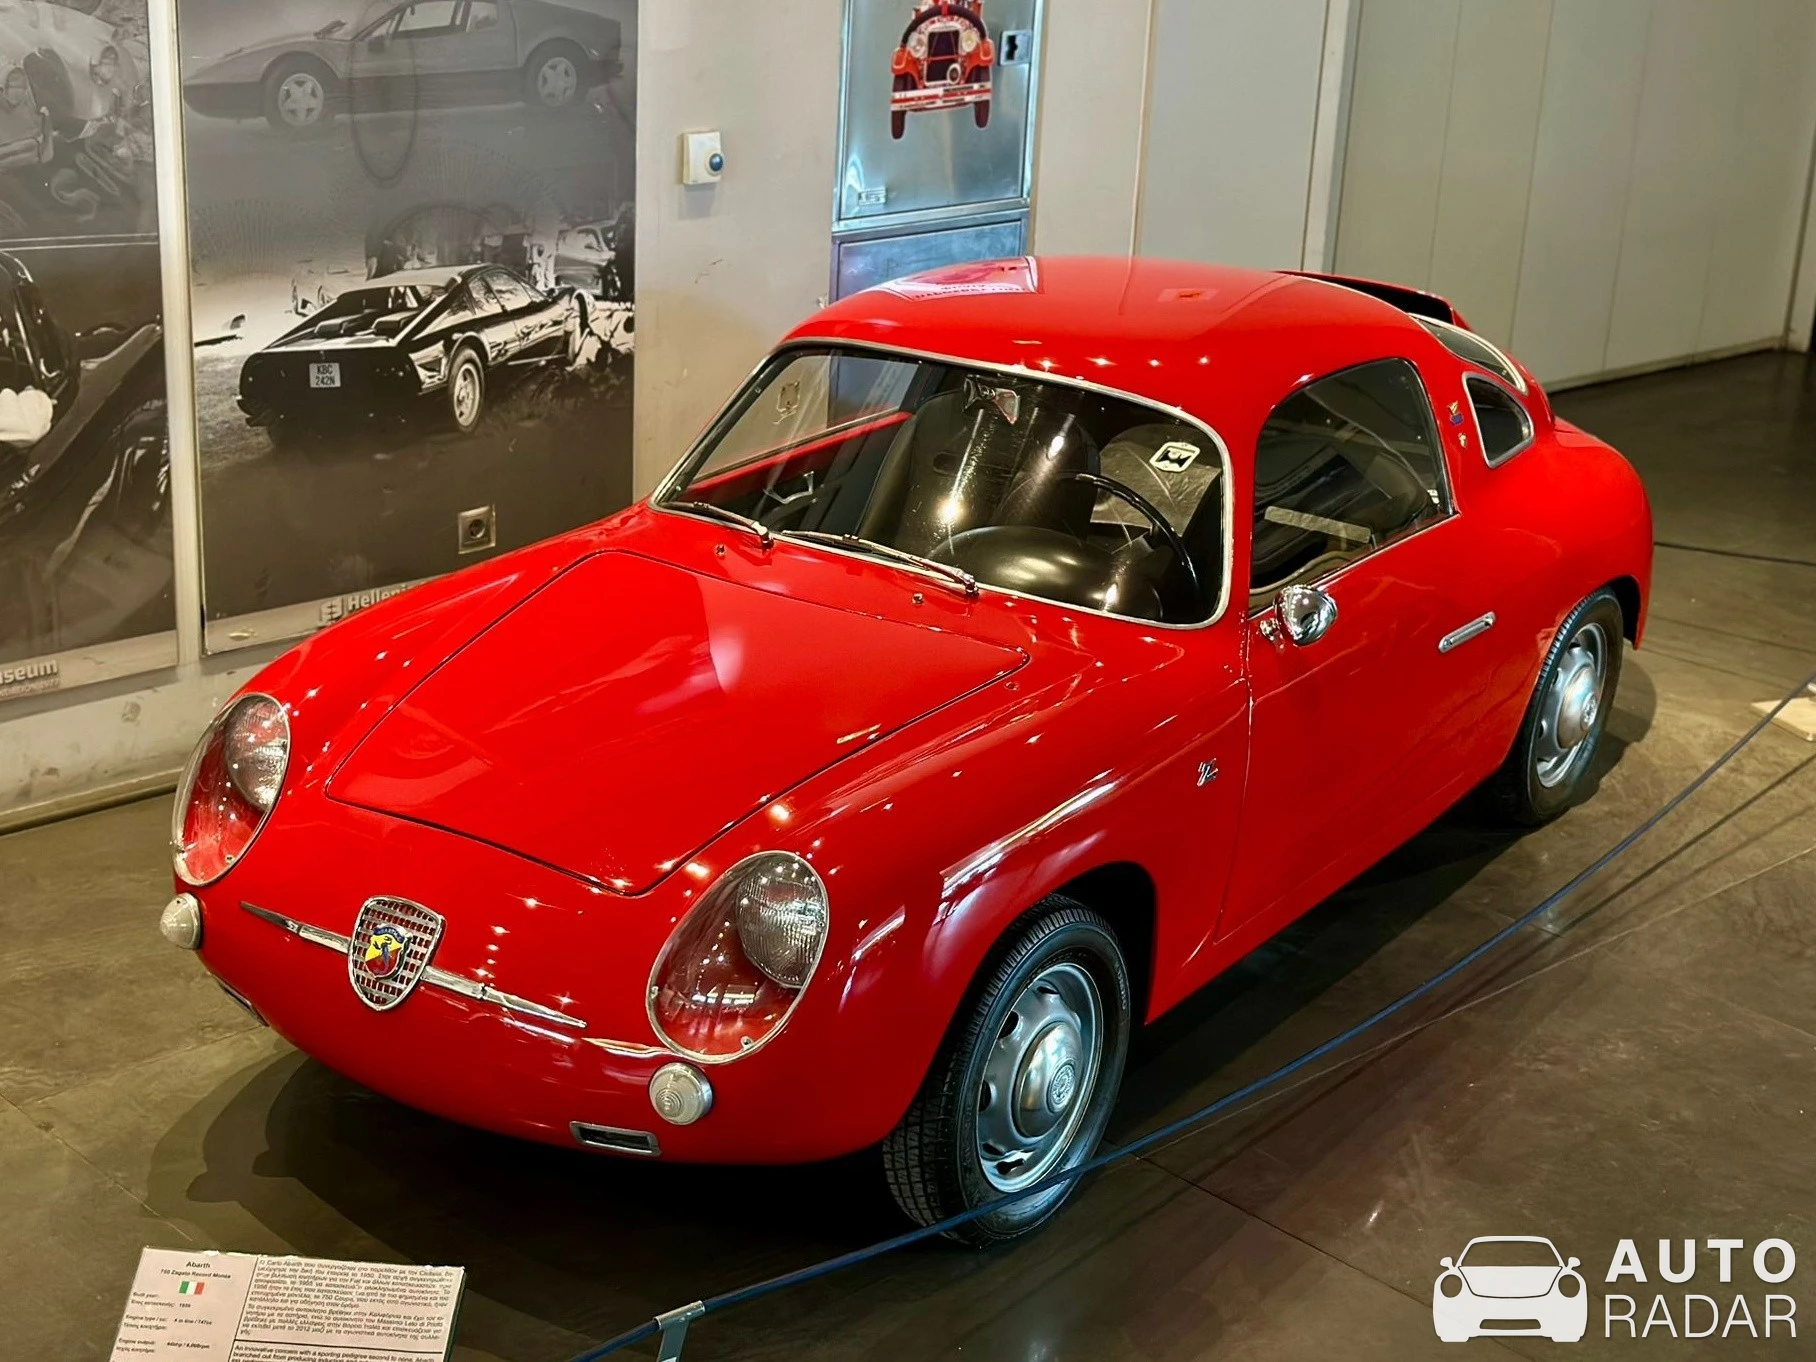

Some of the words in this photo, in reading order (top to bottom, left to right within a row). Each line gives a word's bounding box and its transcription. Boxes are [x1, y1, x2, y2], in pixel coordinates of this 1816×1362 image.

[316, 364, 333, 374] KBC
[316, 376, 336, 386] 242N
[317, 1351, 340, 1359] sporting
